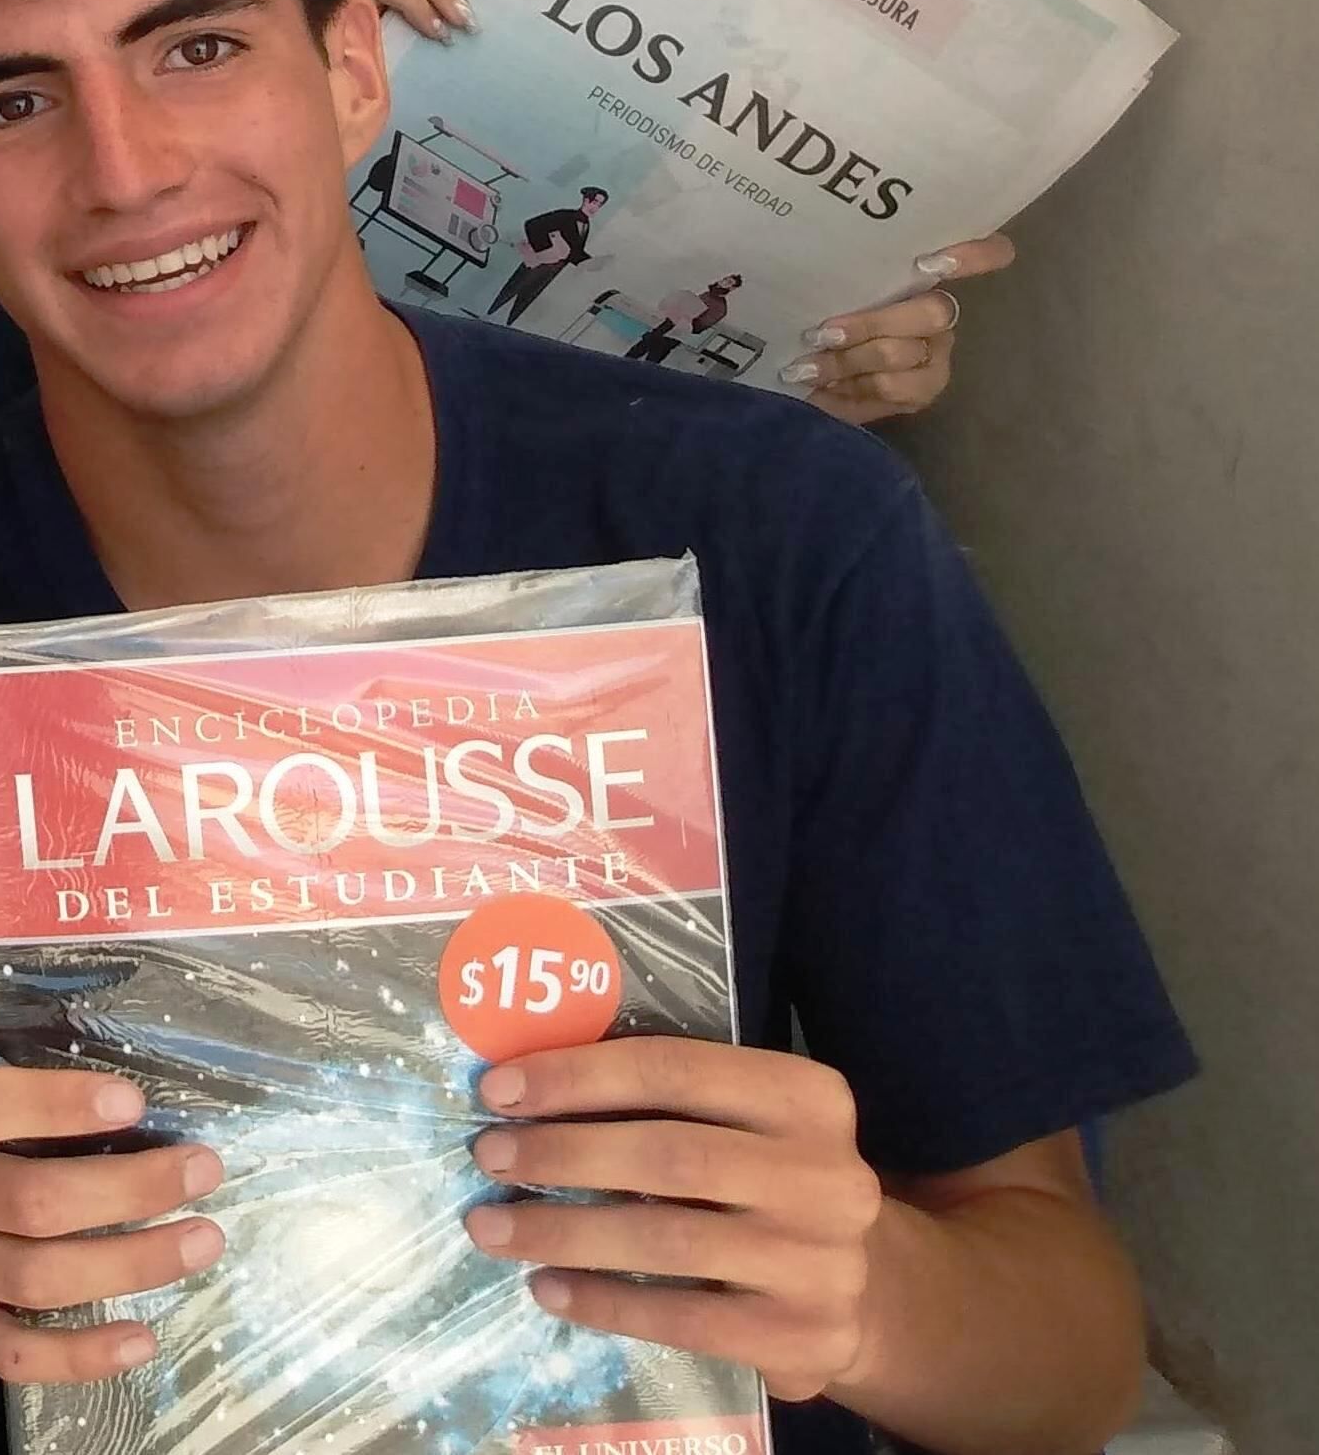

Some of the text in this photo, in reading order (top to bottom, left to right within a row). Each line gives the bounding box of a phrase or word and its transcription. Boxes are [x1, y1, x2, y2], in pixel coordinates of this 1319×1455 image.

[587, 85, 794, 218] PERIODISMO DE VERDAD
[676, 71, 914, 221] ANDES
[115, 689, 541, 748] ENCICLOPEDIA
[14, 727, 656, 872] LAROUSSE
[58, 853, 629, 924] DEL ESTUDIANTE
